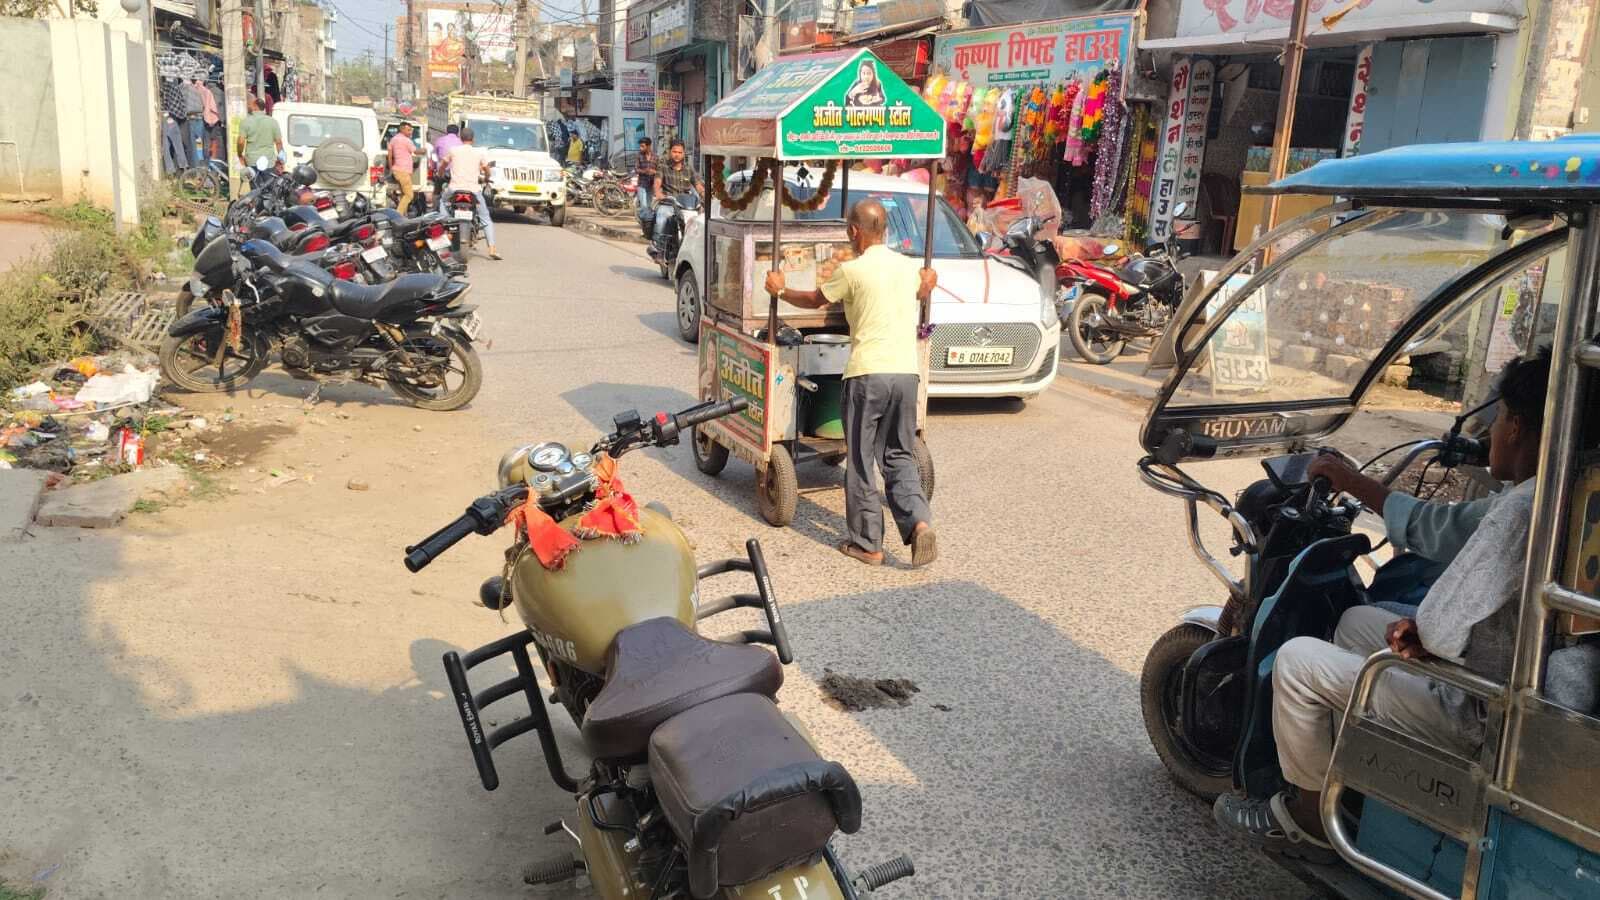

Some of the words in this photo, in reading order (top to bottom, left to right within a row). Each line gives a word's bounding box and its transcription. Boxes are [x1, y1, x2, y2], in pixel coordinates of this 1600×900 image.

[1065, 29, 1123, 63] हाउस
[813, 100, 843, 127] अजीत
[888, 100, 912, 127] स्टॉल
[720, 354, 764, 400] अजीत
[1360, 752, 1461, 808] MAYURI
